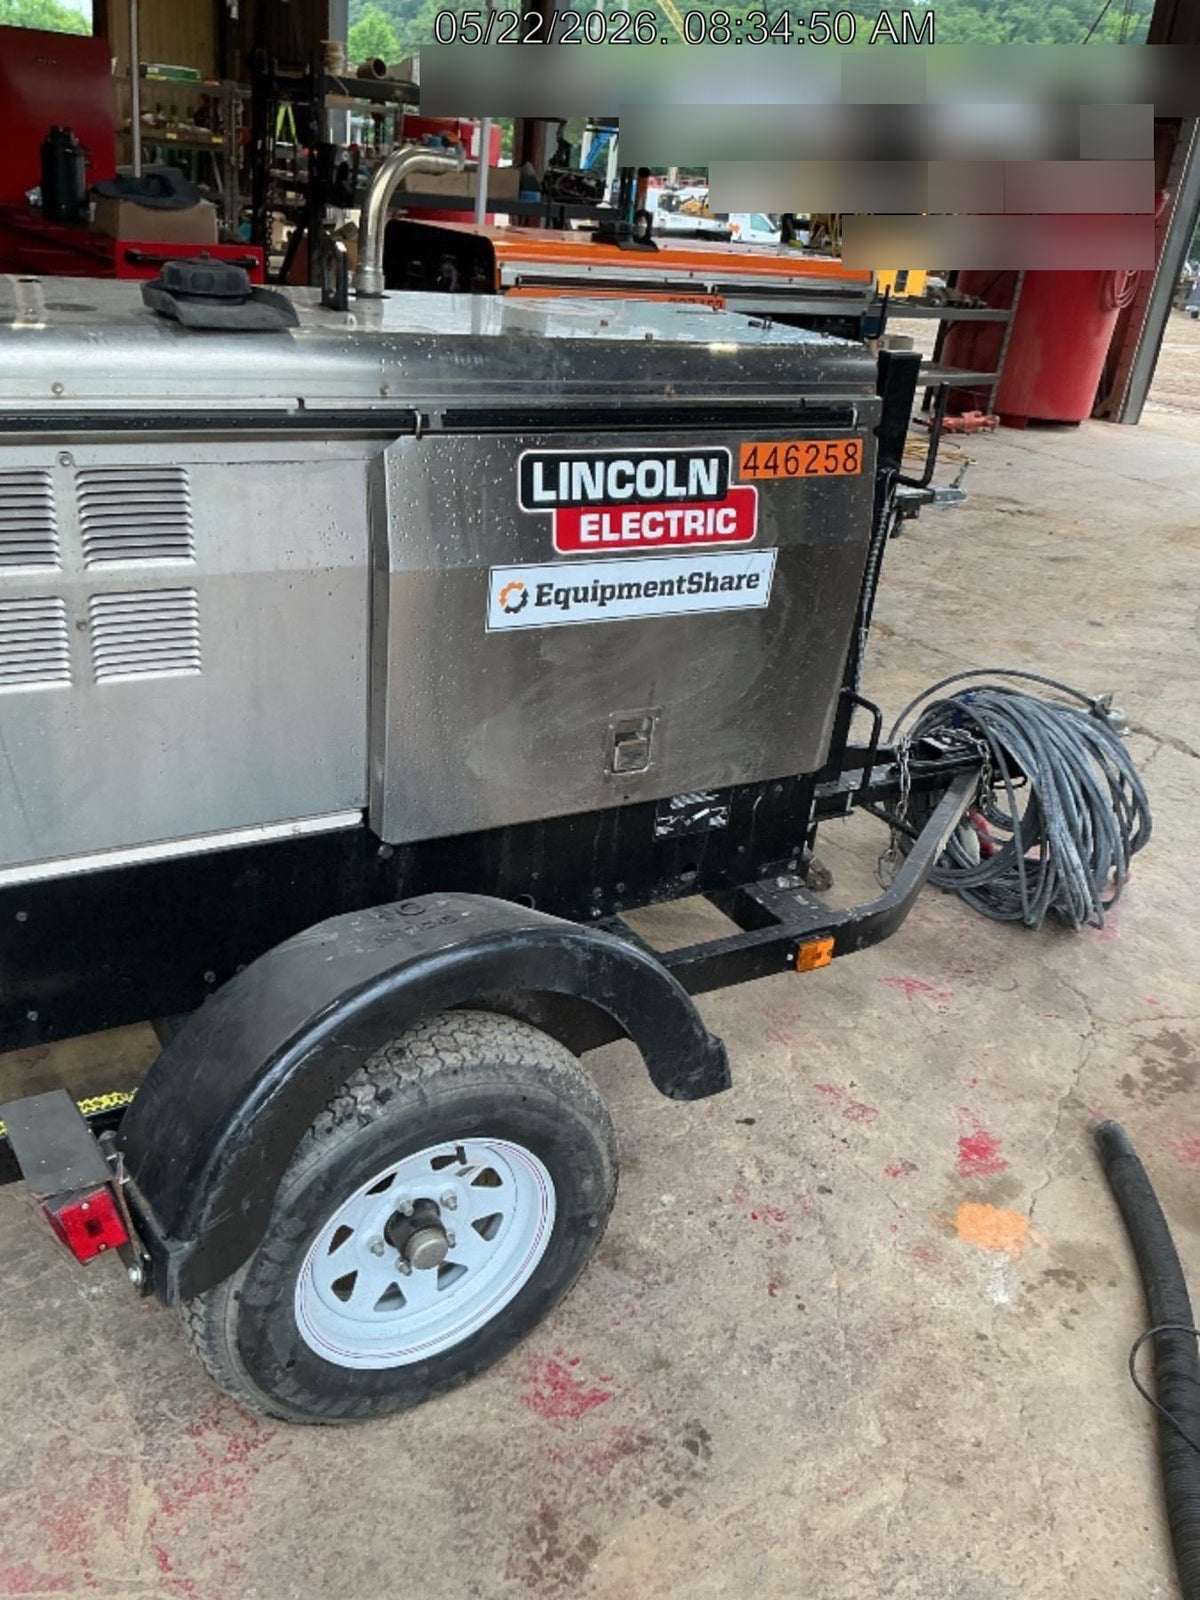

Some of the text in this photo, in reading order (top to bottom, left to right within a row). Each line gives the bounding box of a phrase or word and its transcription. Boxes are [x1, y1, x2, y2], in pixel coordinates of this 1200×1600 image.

[742, 442, 859, 477] 446258
[532, 457, 720, 502] LINCOLN
[579, 507, 738, 543] ELECTRIC
[534, 571, 761, 610] EquipmentShare
